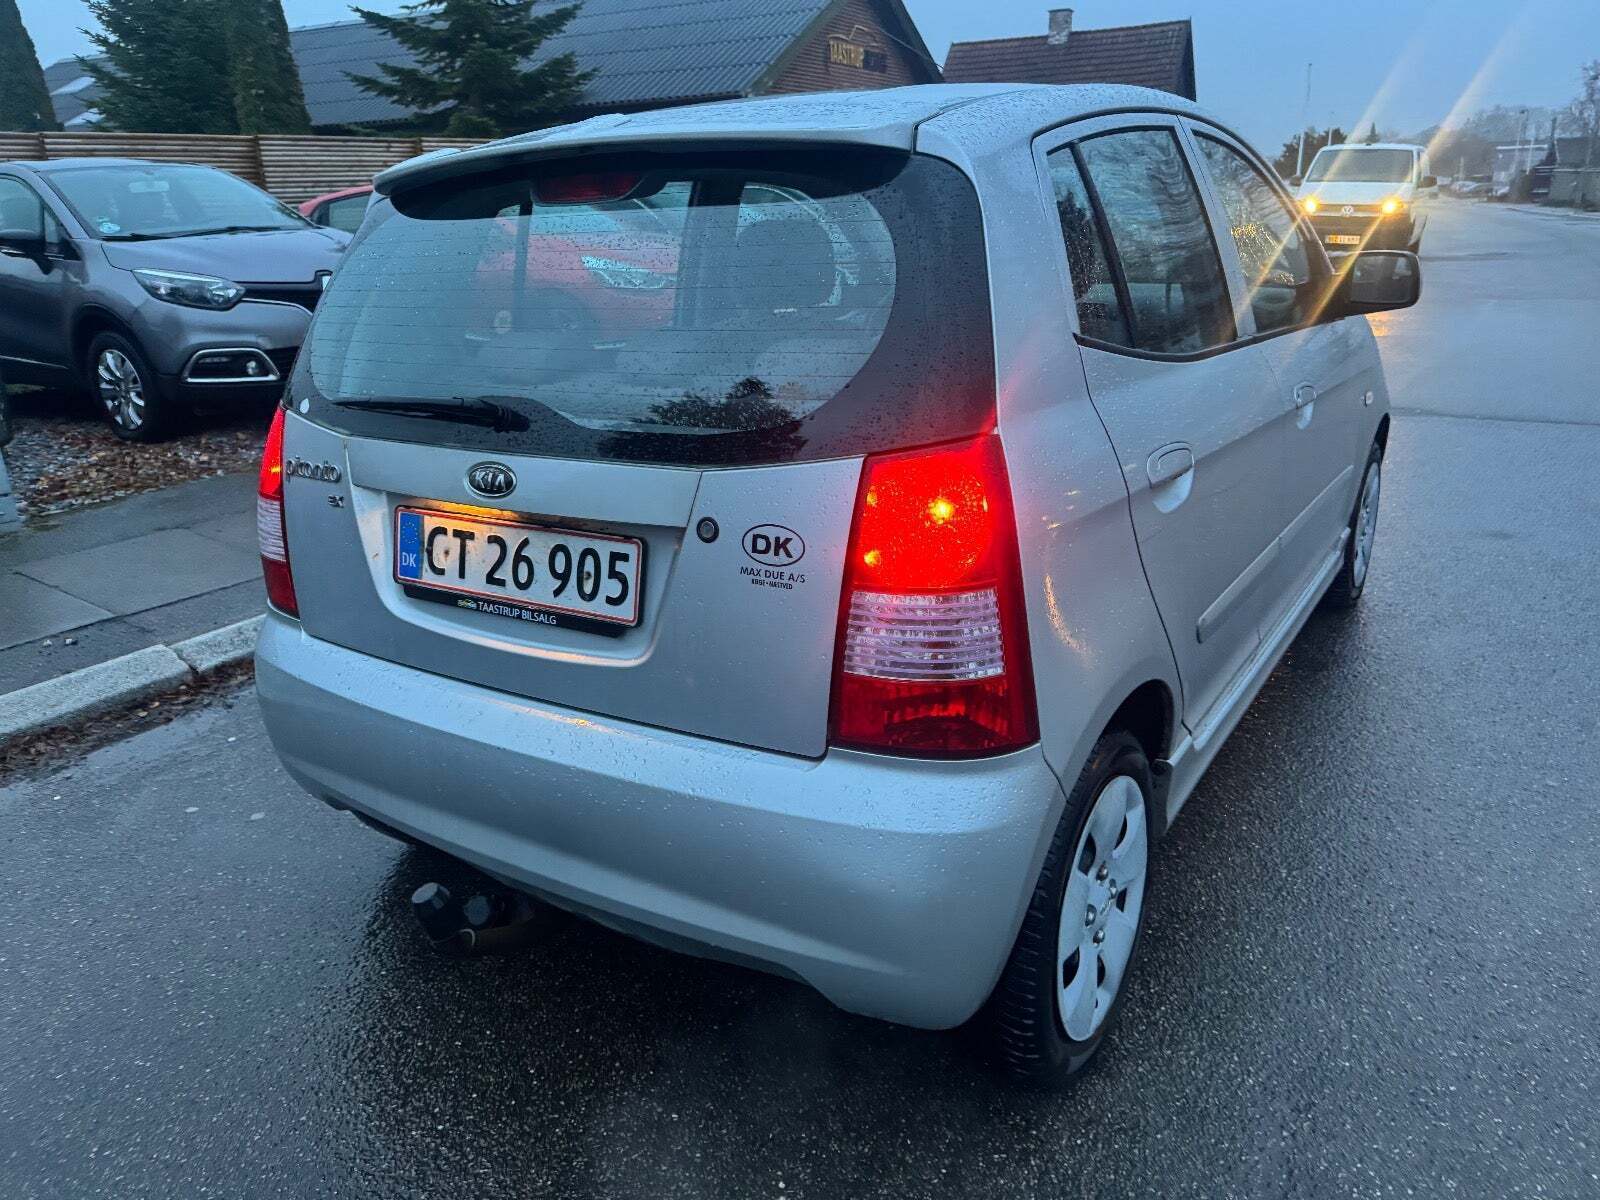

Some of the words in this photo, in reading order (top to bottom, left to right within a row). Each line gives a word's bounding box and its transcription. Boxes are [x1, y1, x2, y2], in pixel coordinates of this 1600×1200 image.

[472, 470, 507, 492] KIA
[751, 533, 794, 559] DK
[402, 551, 417, 568] DK
[426, 525, 475, 580] CT
[485, 534, 535, 591] 26
[548, 543, 630, 606] 905
[740, 566, 762, 577] MAX
[764, 569, 785, 581] DUE
[788, 573, 806, 584] A/S
[478, 601, 521, 618] TAASTRUP
[521, 609, 557, 625] BILSALG
